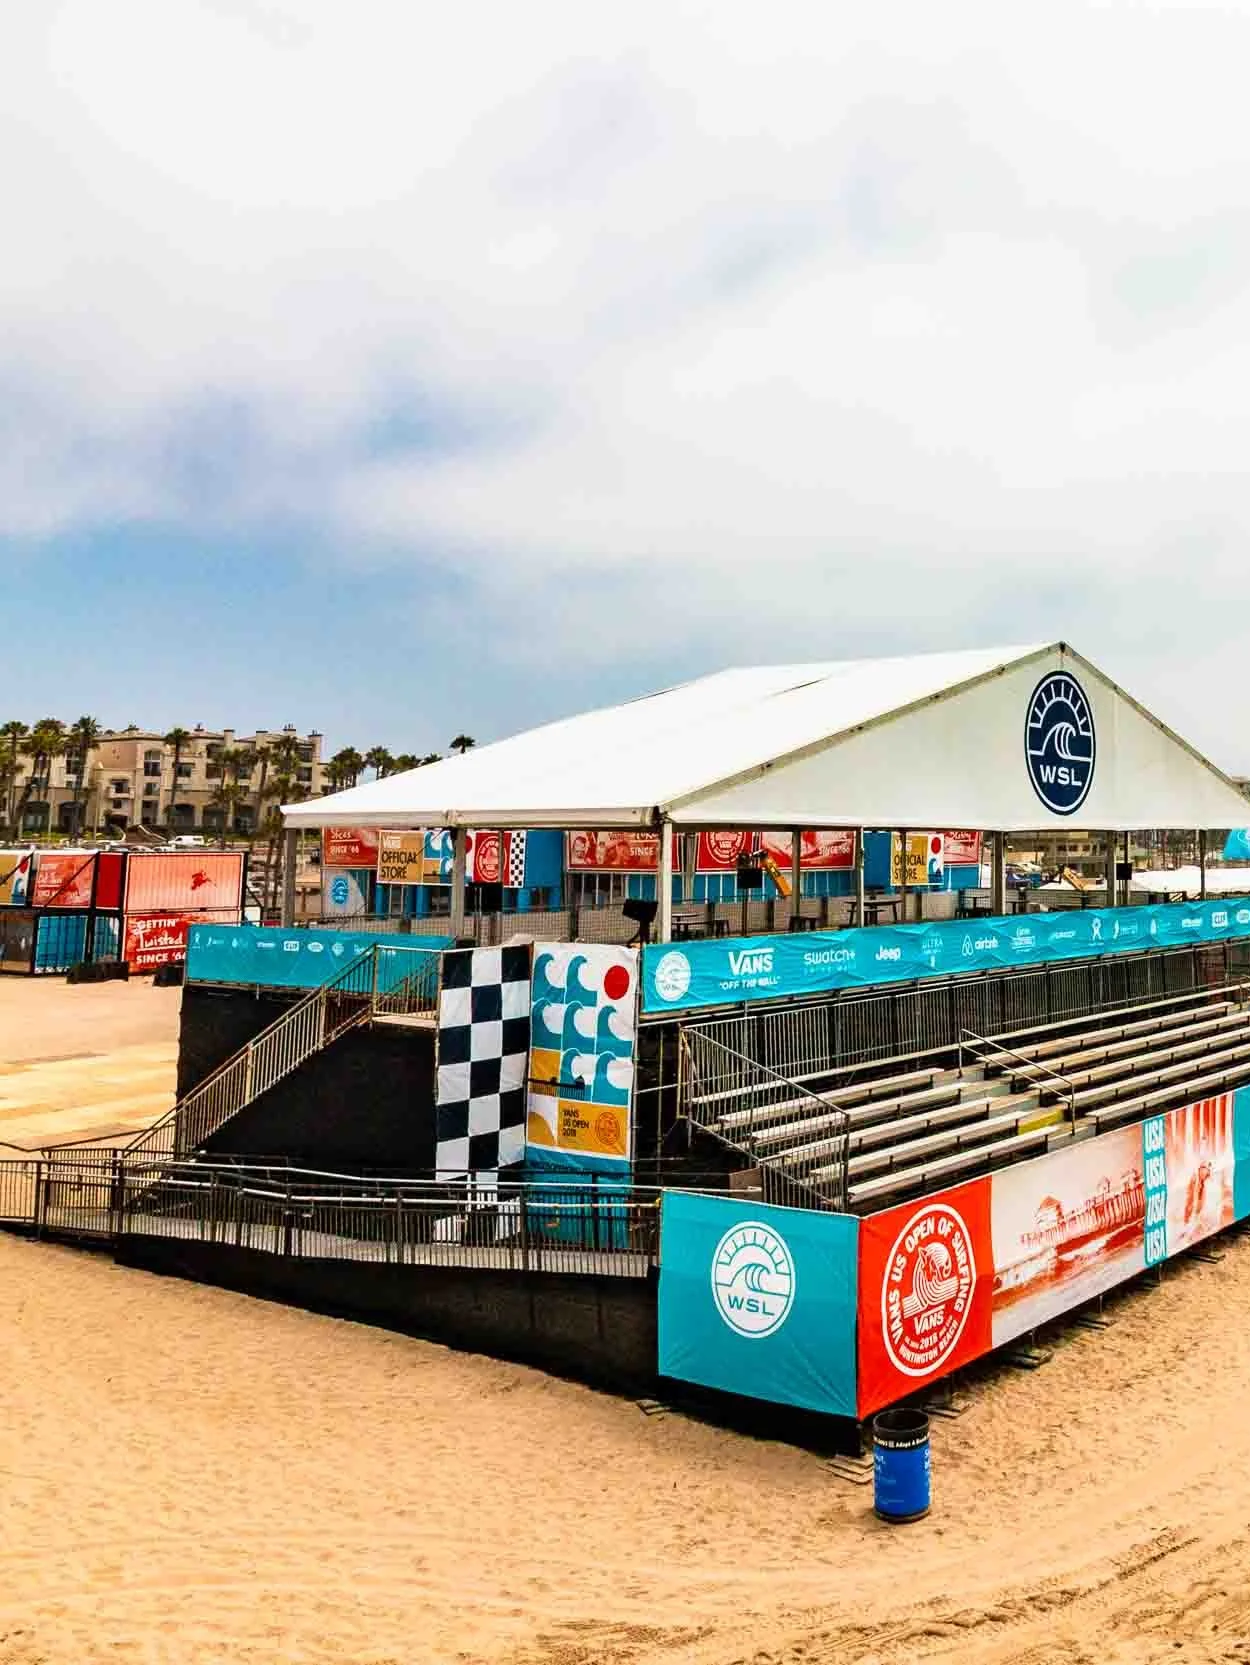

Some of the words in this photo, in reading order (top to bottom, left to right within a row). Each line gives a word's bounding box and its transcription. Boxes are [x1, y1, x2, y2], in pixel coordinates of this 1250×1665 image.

[1040, 764, 1082, 786] WSL
[381, 850, 417, 864] OFFICIAL
[381, 865, 407, 879] STORE
[136, 952, 169, 965] SINCE
[728, 947, 775, 976] VANS
[875, 945, 901, 962] Jeep
[1145, 1118, 1164, 1154] USA
[1145, 1154, 1166, 1190] USA
[1147, 1190, 1166, 1227] USA
[1146, 1227, 1166, 1263] USA
[904, 1215, 935, 1252] OPEN
[937, 1217, 954, 1238] OF
[951, 1231, 971, 1314] SURFING
[728, 1293, 775, 1316] WSL
[913, 1304, 947, 1336] VANS
